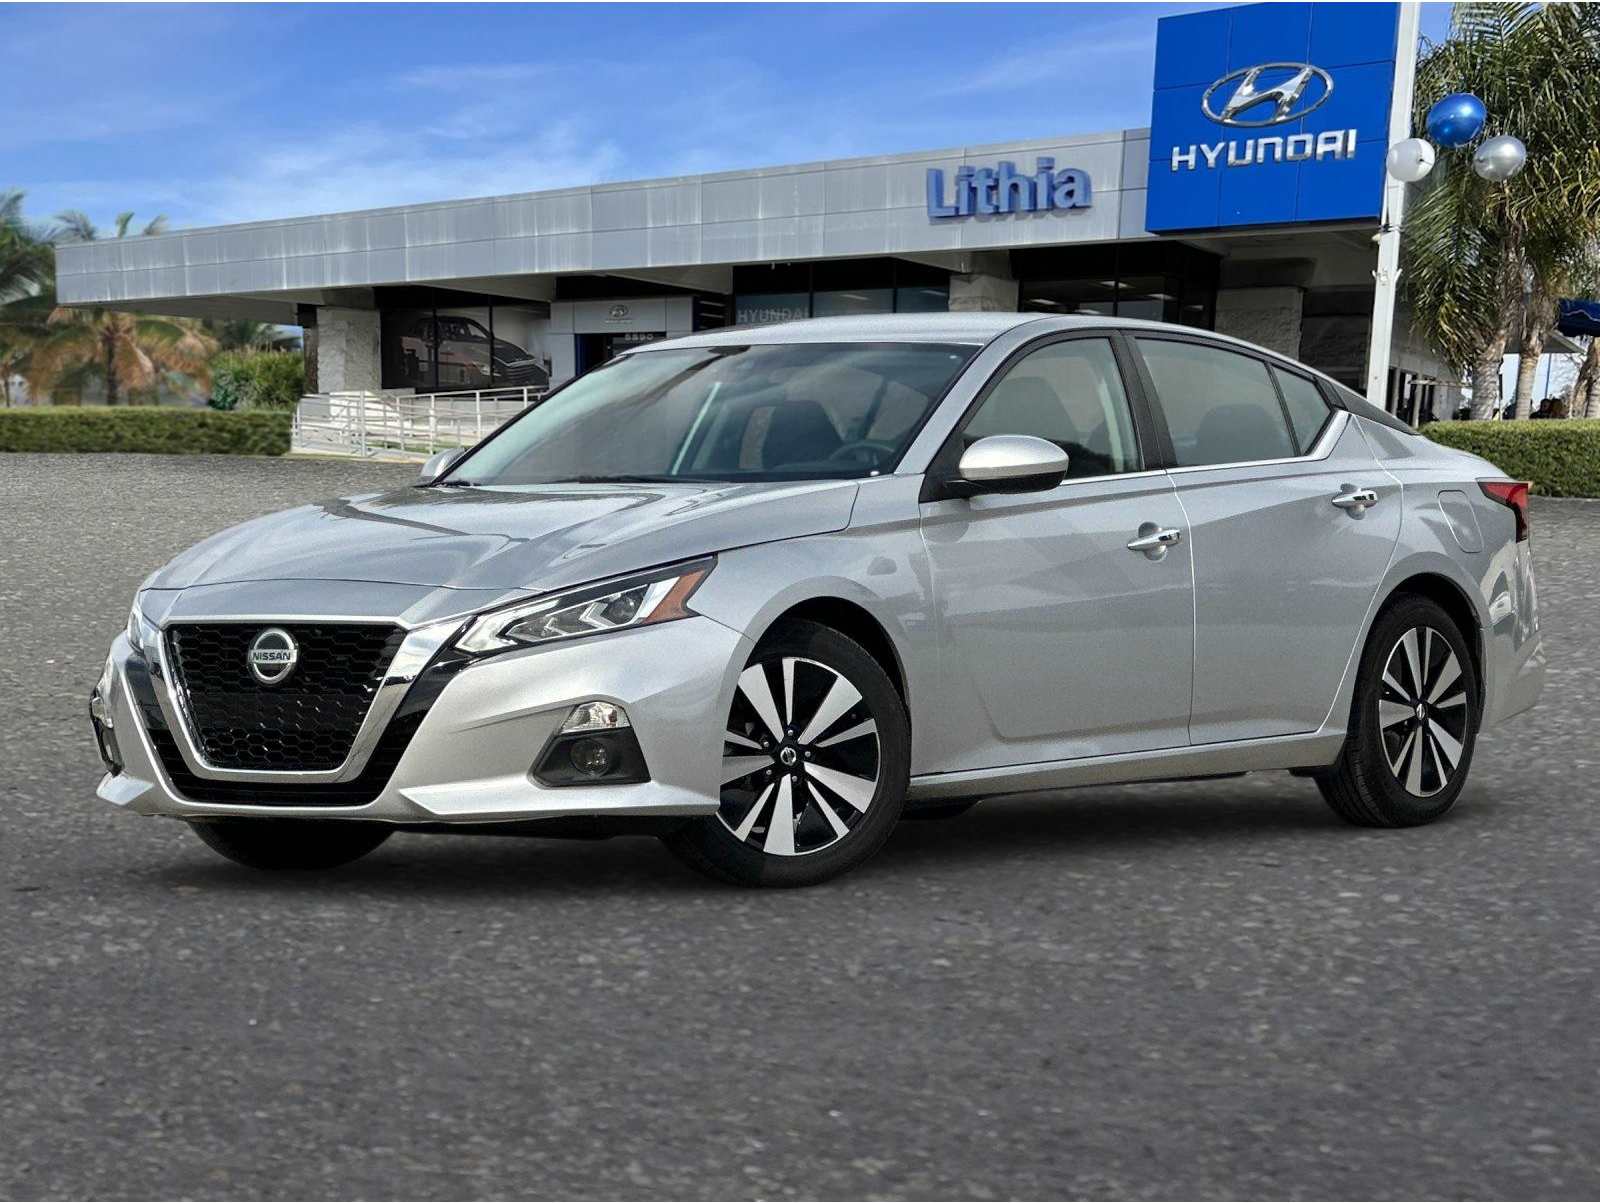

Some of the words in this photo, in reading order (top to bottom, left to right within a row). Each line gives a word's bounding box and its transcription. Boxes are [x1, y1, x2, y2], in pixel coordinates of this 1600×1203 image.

[1171, 129, 1357, 172] HYUNDAI
[927, 157, 1092, 218] Lithia
[253, 651, 291, 661] NISSAN
